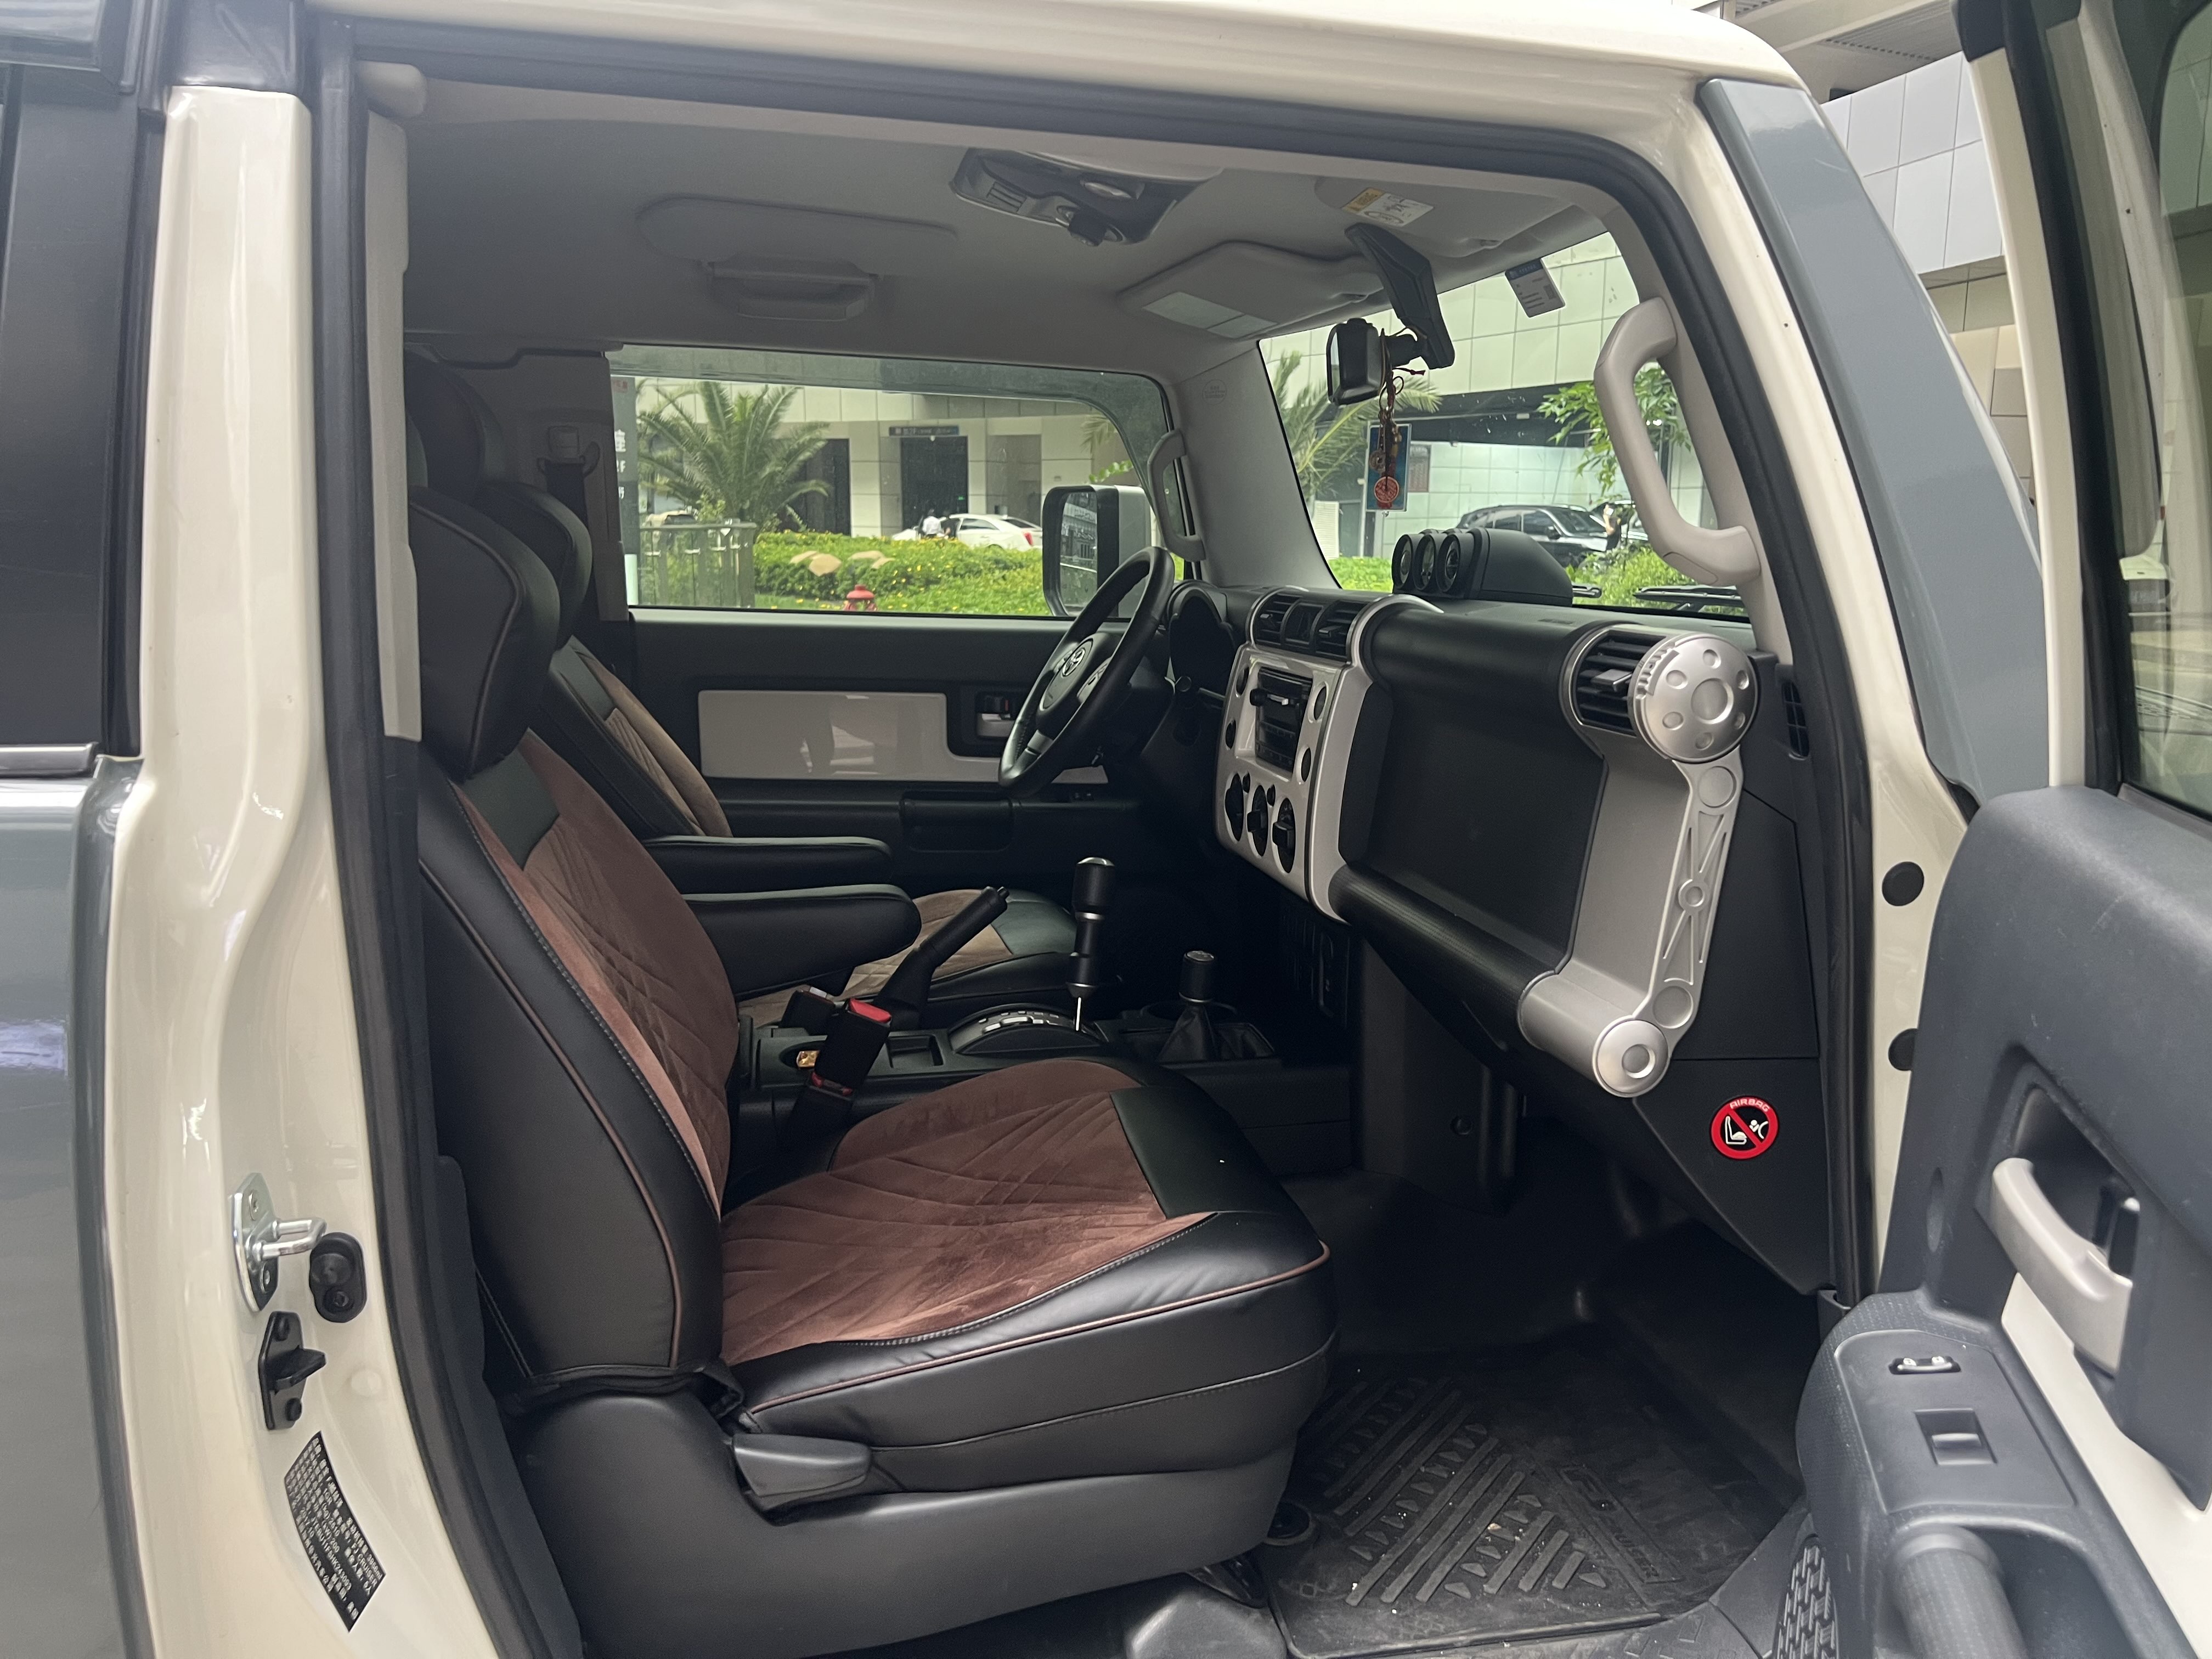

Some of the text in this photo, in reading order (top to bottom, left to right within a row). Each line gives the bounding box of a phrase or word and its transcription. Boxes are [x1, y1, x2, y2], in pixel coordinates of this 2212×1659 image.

[1730, 1098, 1770, 1112] AIRBAG
[351, 1541, 359, 1555] FJ
[356, 1551, 378, 1588] CRUISER
